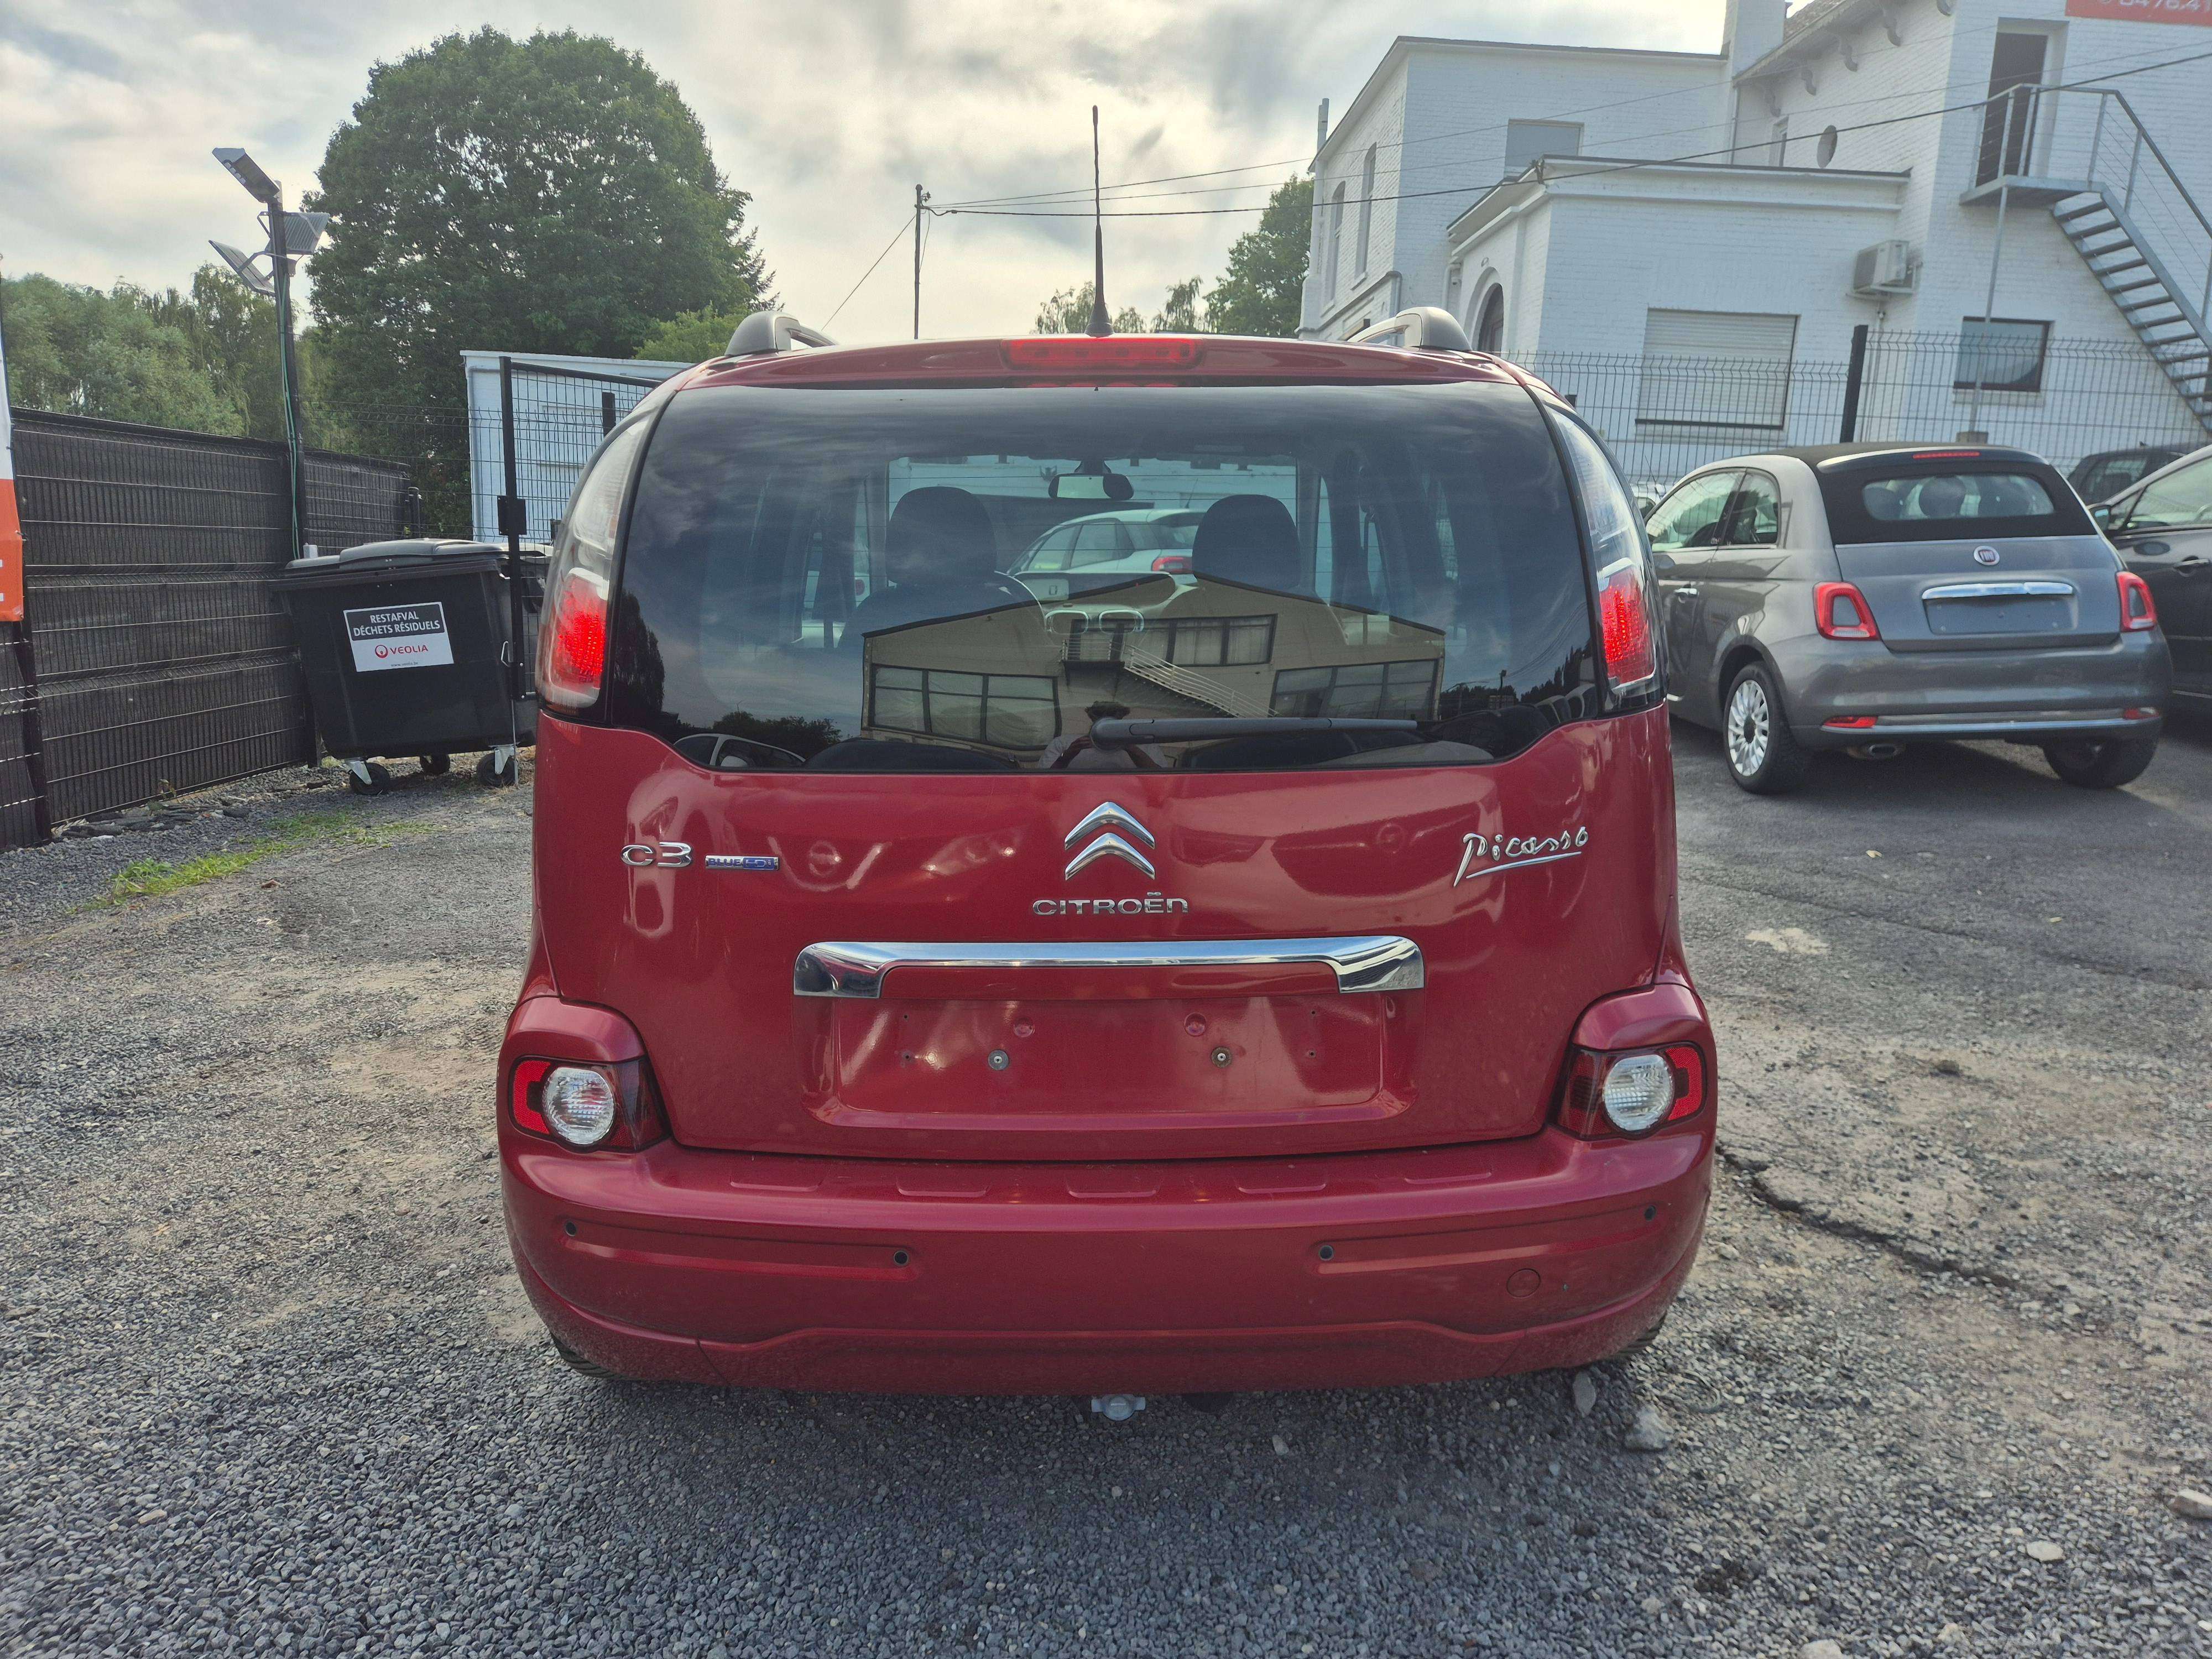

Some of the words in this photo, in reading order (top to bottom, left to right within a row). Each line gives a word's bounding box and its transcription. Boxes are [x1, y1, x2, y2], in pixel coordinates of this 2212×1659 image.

[370, 611, 419, 623] RESTAFVAL
[353, 625, 393, 637] DÉCHETS
[394, 620, 440, 632] RÉSIDUELS
[389, 645, 429, 654] VEOLIA
[621, 841, 692, 868] C3
[1453, 826, 1588, 886] Picasso
